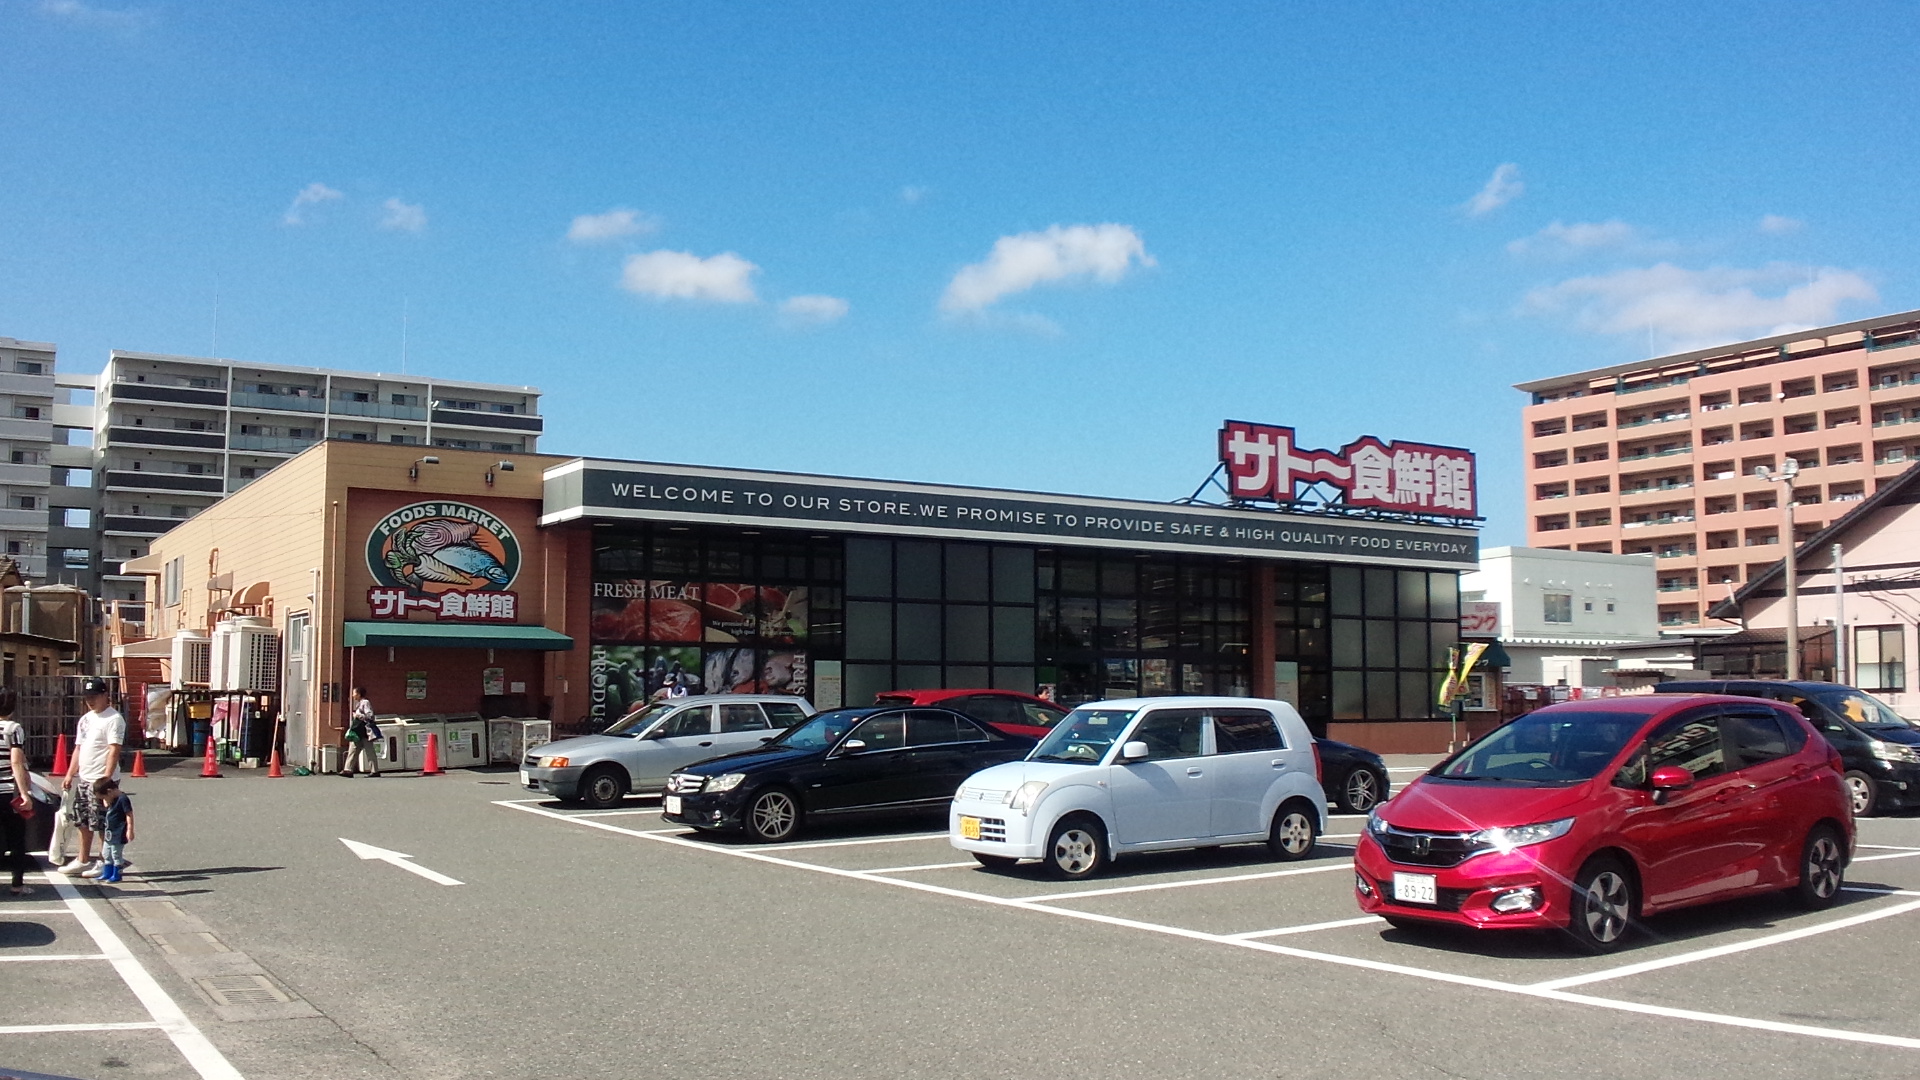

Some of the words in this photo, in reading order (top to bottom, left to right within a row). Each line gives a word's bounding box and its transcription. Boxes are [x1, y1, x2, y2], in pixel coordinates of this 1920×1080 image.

[378, 504, 437, 537] FOODS
[441, 504, 511, 541] MARKET
[611, 482, 735, 505] WELCOME
[743, 491, 773, 506] TO
[783, 494, 830, 510] OUR
[956, 507, 1046, 525] PROMISE
[1053, 514, 1078, 527] TO
[1084, 516, 1165, 533] PROVIDE
[1170, 523, 1214, 537] SAFE
[1219, 526, 1230, 538] &
[1235, 527, 1275, 541] HIGH
[1280, 530, 1346, 546] QUALITY
[1350, 536, 1391, 549] FOOD
[1395, 539, 1472, 555] EVERYDAY.
[593, 582, 646, 599] FRESH
[650, 584, 700, 601] MEAT
